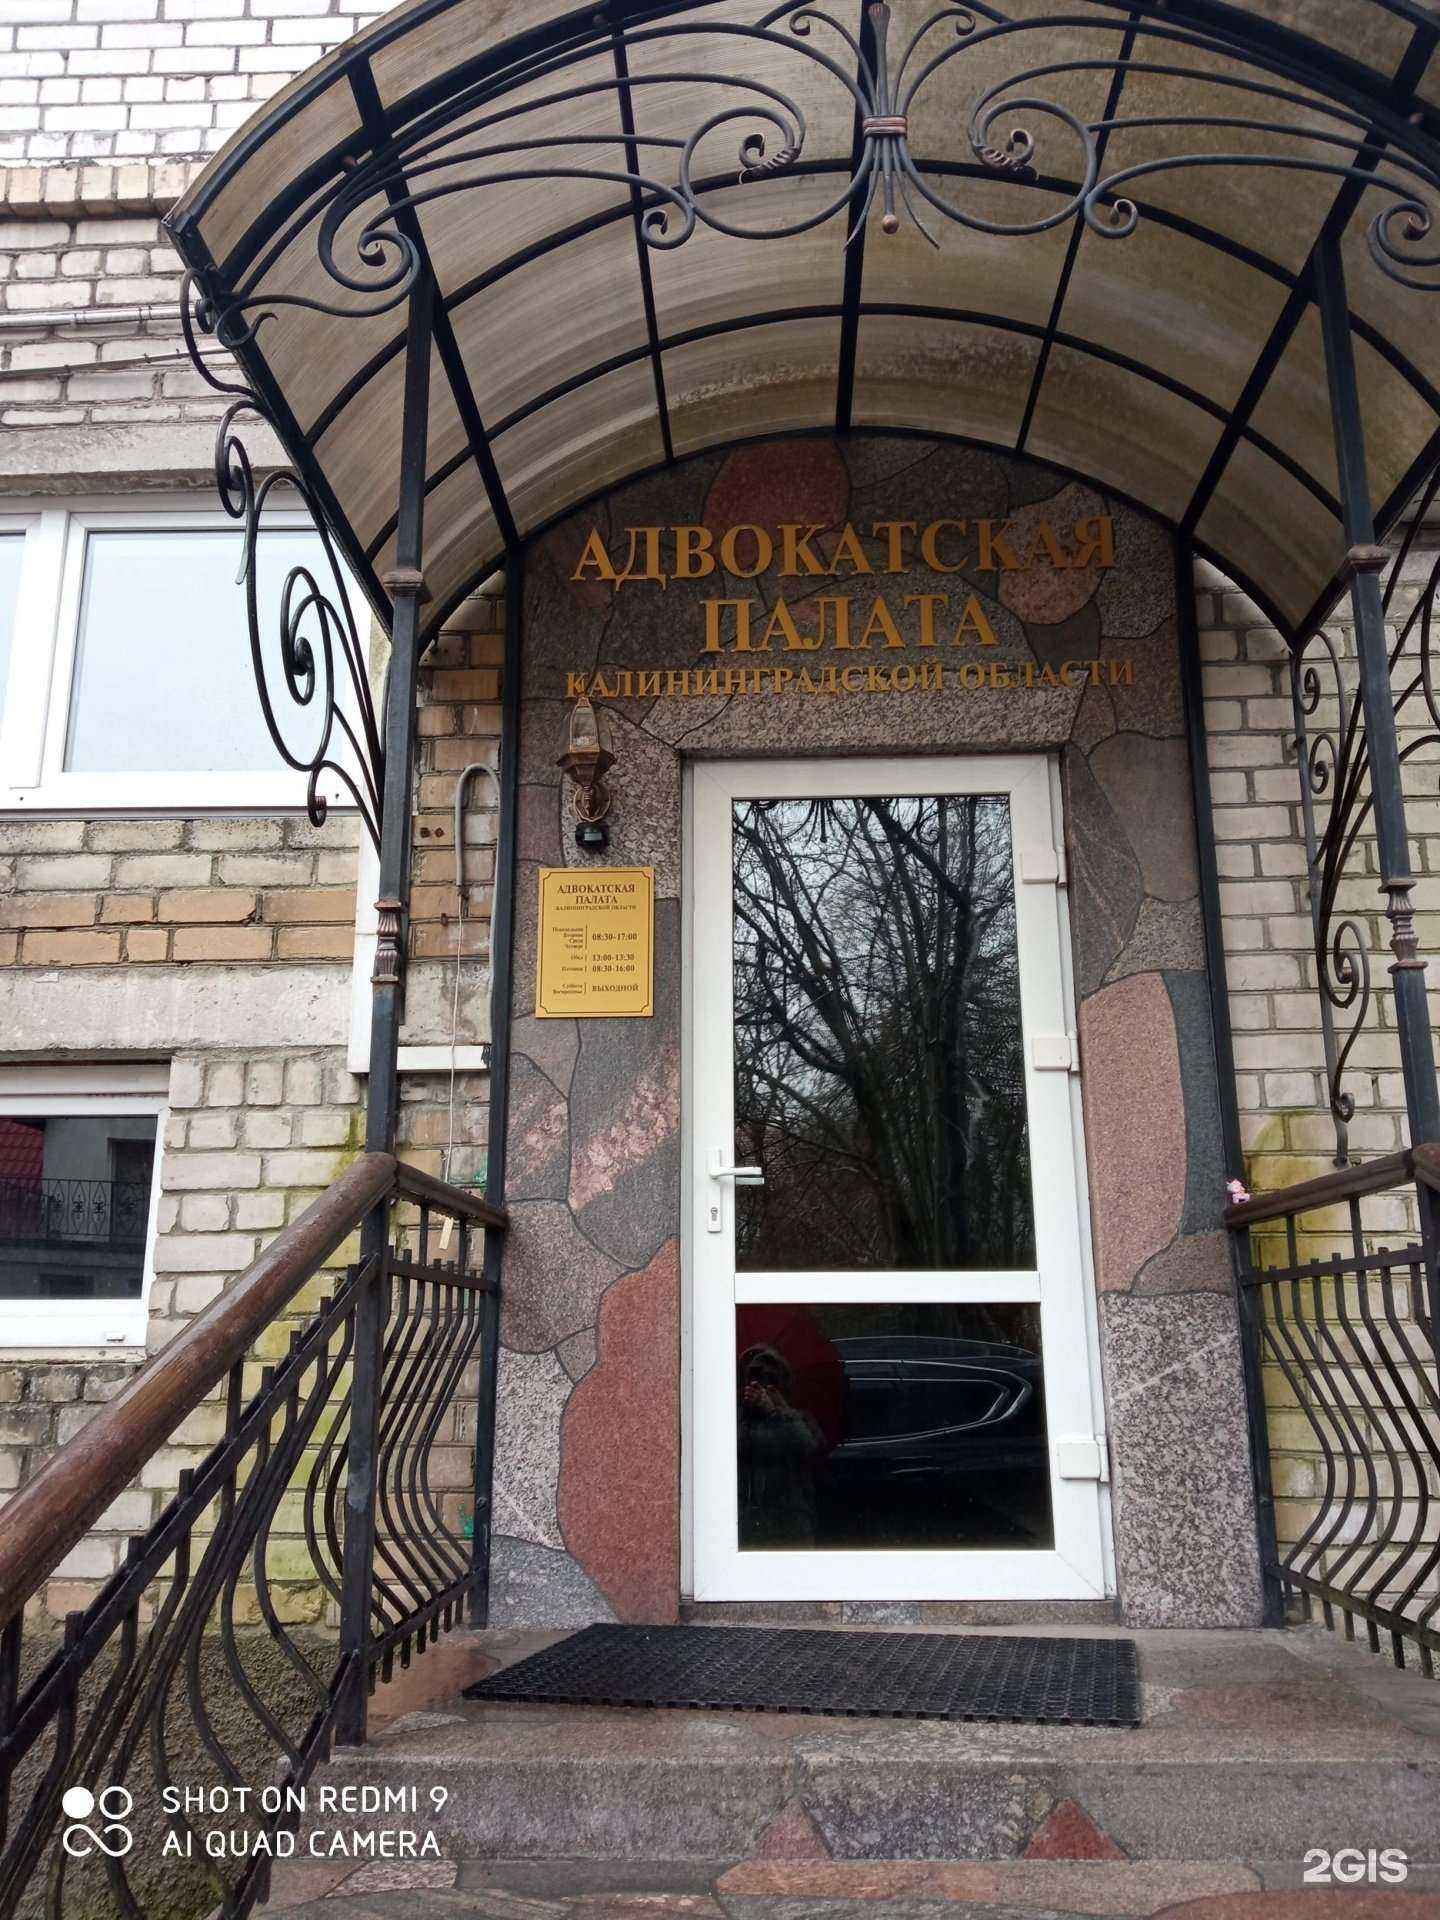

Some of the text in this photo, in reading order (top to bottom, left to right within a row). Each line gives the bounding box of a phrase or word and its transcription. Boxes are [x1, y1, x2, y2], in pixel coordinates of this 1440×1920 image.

[570, 515, 1115, 591] АДВОКАТСКАЯ
[700, 593, 998, 653] ПАЛАТА
[565, 657, 1135, 699] КАЛИНИНГРАДСКОЙ ОБЛАСТИ
[557, 884, 635, 894] АДВОКАТСКАЯ
[575, 895, 618, 904] ПАЛАТА
